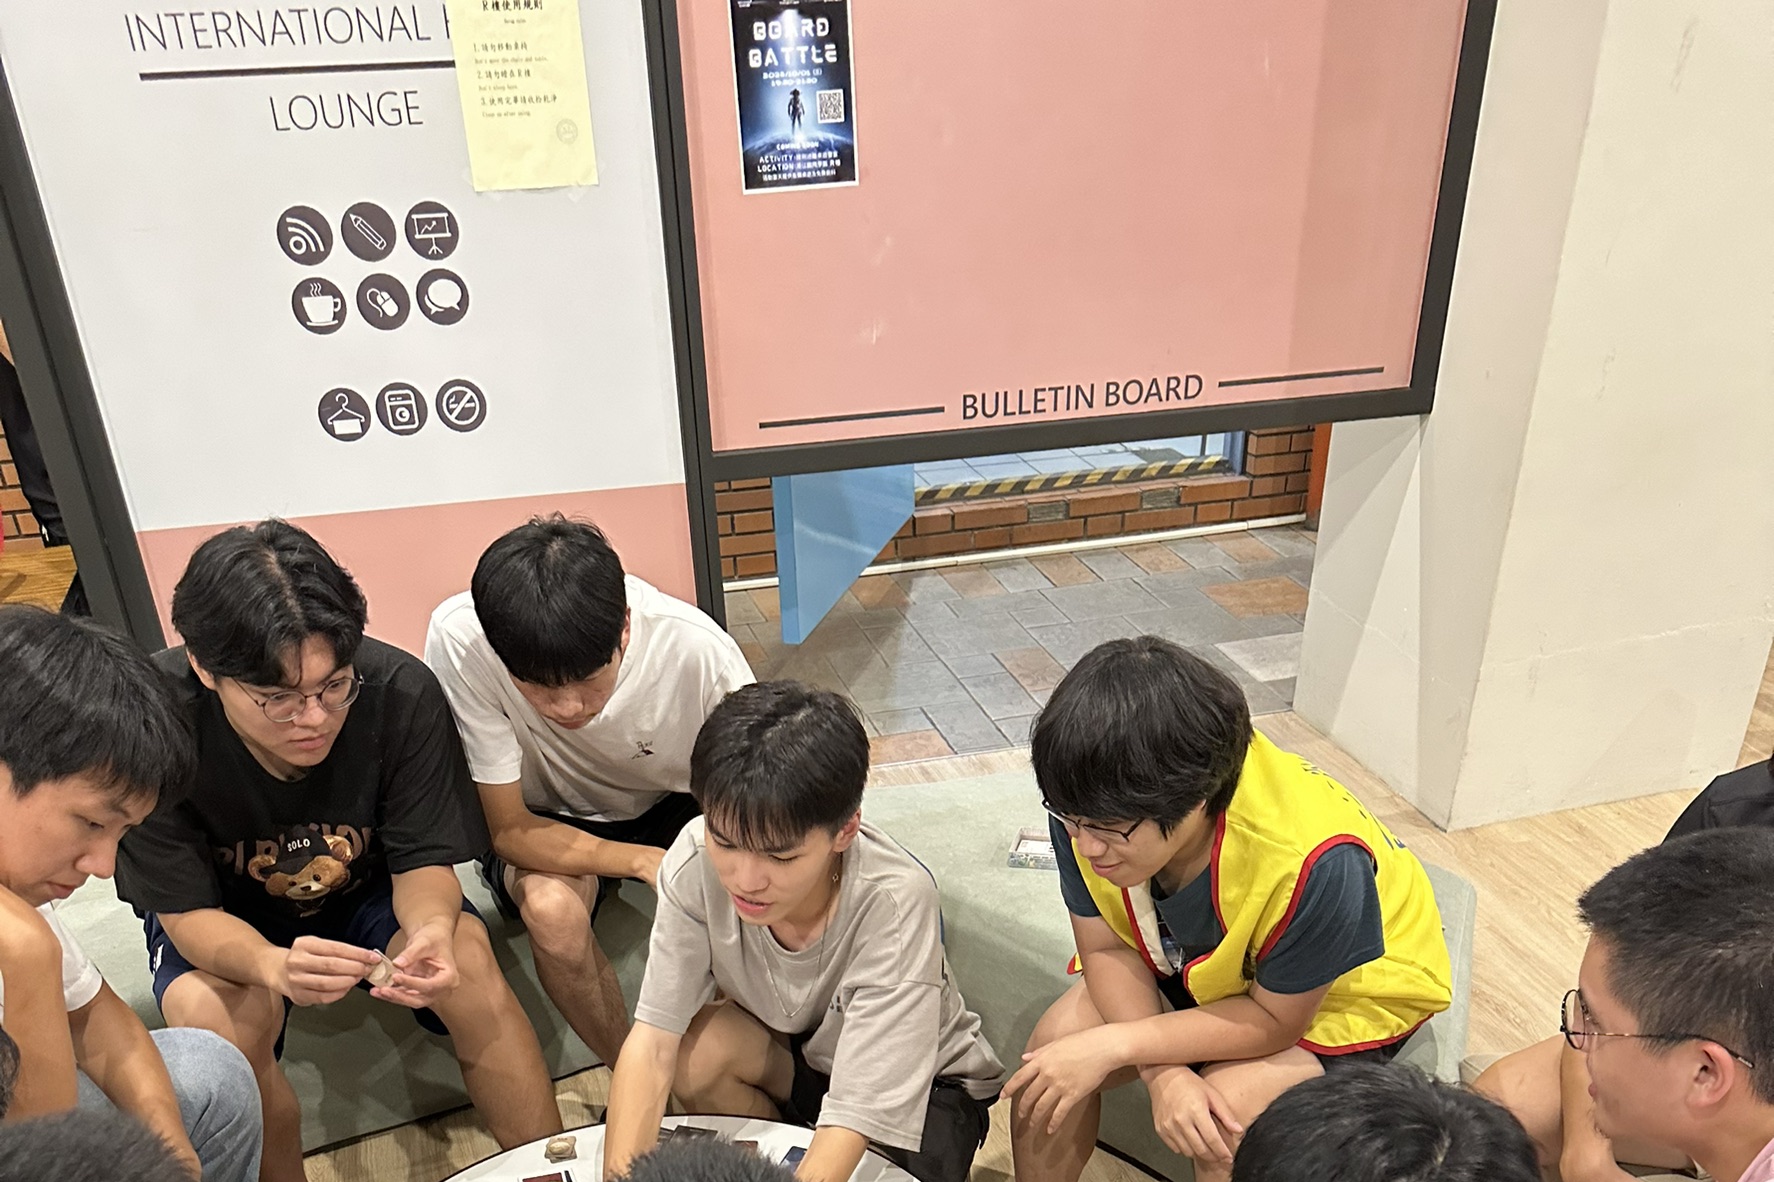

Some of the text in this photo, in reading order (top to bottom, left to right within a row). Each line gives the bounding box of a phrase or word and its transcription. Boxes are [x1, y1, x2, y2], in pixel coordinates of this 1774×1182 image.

[124, 4, 432, 52] INTERNATIONAL
[752, 17, 830, 41] BOARD
[748, 43, 838, 68] BATTLE
[269, 89, 424, 132] LOUNGE
[961, 373, 1204, 421] BULLETIN BOARD
[287, 838, 311, 852] SOLO
